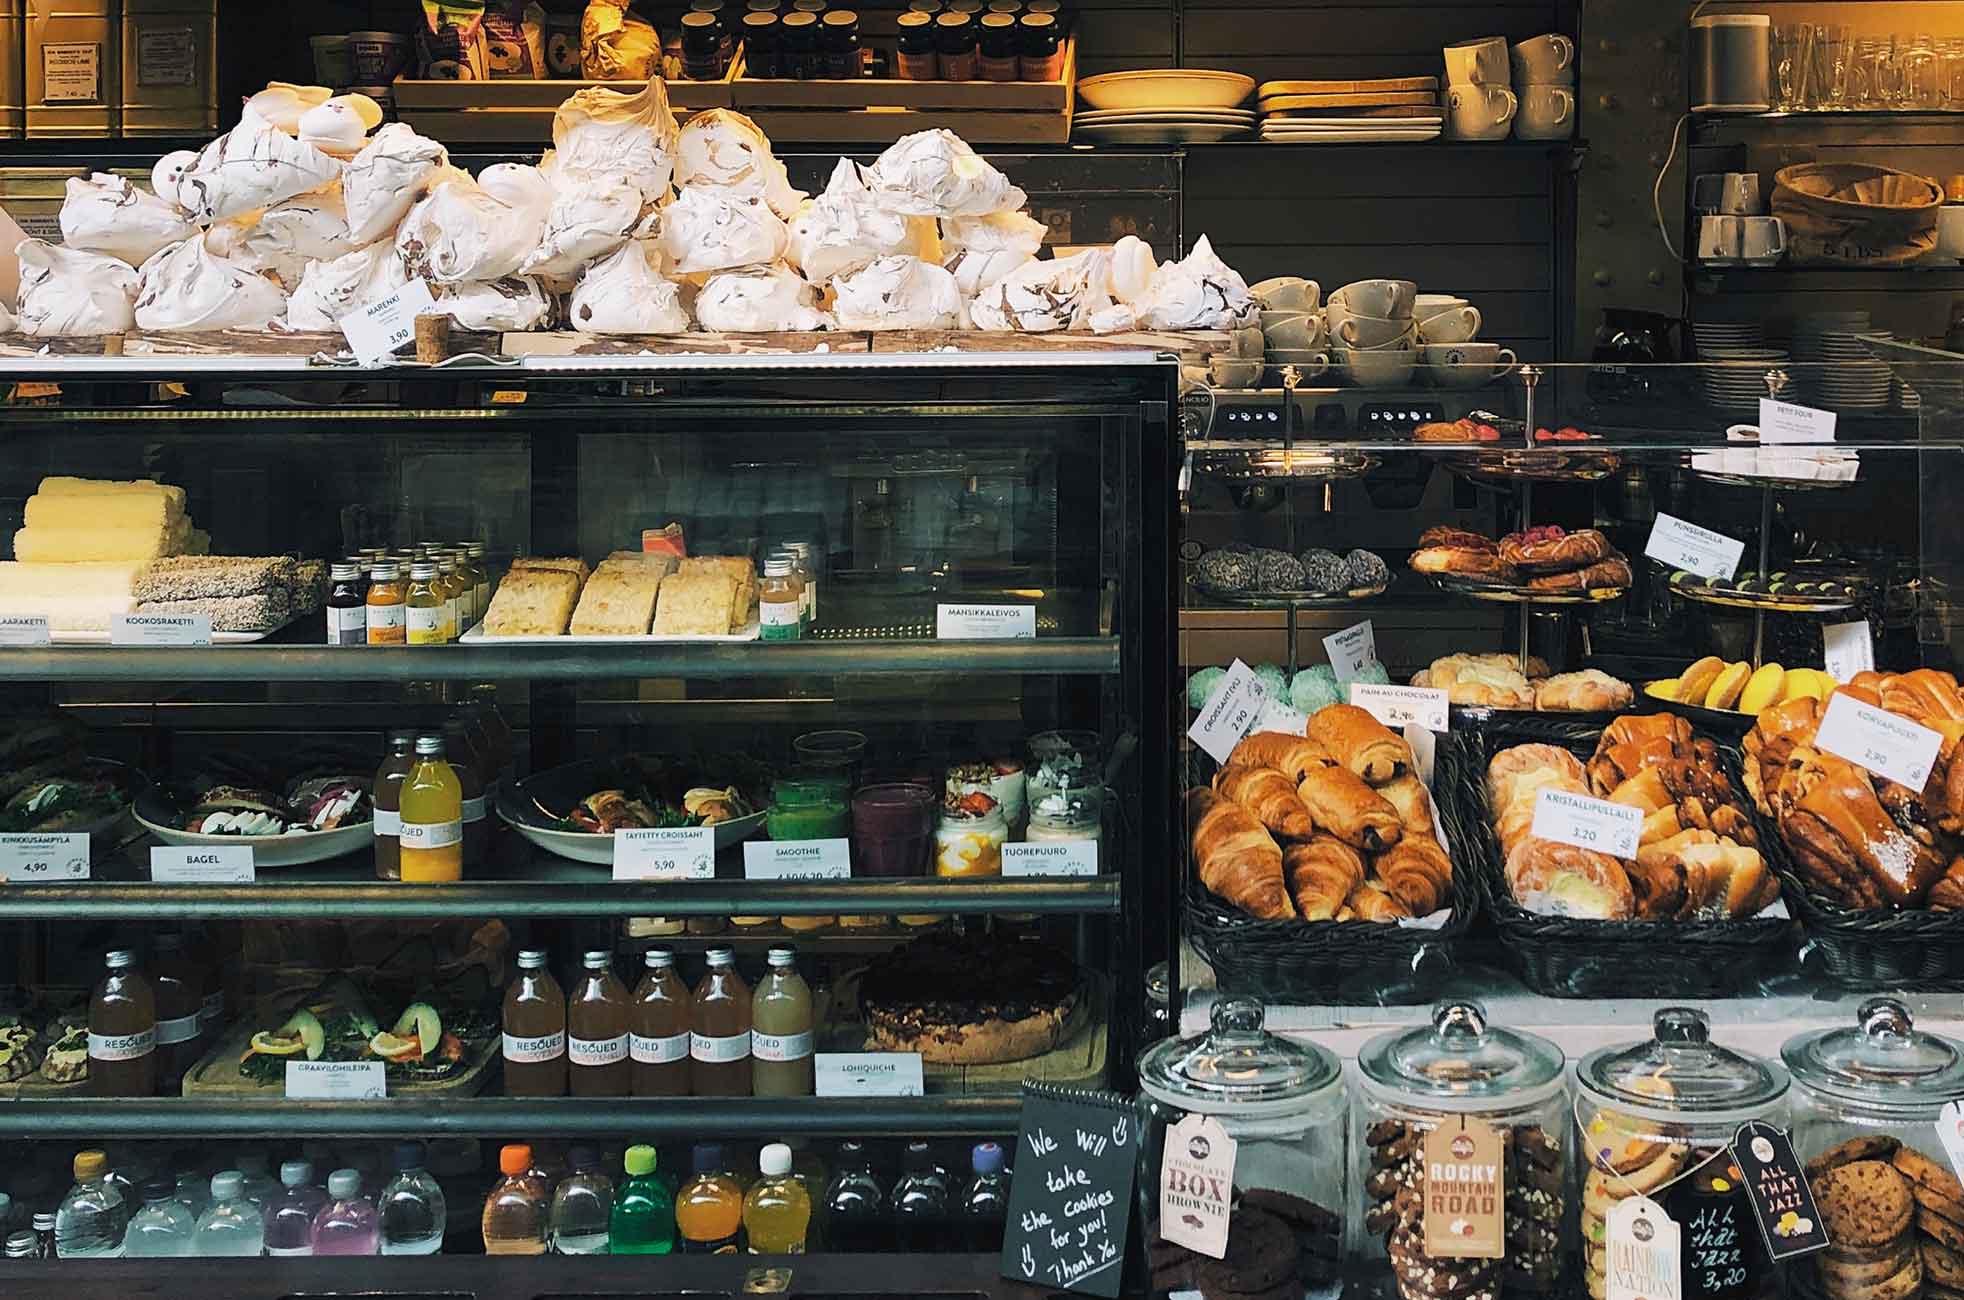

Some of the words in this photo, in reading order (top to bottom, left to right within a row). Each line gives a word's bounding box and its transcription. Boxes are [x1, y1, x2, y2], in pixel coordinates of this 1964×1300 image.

[367, 294, 400, 314] MARENKI
[389, 329, 409, 344] 3,90
[126, 617, 194, 626] KOOKOSRAKETTI
[948, 608, 1021, 616] MANSIKKALEIVOS
[1394, 690, 1440, 699] CHOCOLAT
[1203, 691, 1233, 732] CROISSANT
[660, 831, 703, 840] CROISSANT
[187, 856, 220, 864] BAGEL
[776, 848, 821, 856] SMOOTHIE
[1005, 847, 1067, 857] TUOREPUURO
[24, 863, 47, 872] 4,90
[654, 861, 675, 871] 5,90
[517, 1036, 562, 1051] RESCUED
[572, 1042, 617, 1053] RESCUED
[842, 1064, 896, 1073] LOHIQUICHE
[1027, 1127, 1059, 1158] We
[1076, 1128, 1108, 1157] Will
[1046, 1164, 1091, 1192] take
[1431, 1163, 1496, 1183] ROCKY
[1760, 1165, 1787, 1181] ALL
[1168, 1167, 1226, 1203] BOX
[1431, 1181, 1496, 1196] MOUNTAIN
[1757, 1176, 1797, 1198] THAT
[1021, 1210, 1053, 1232] the
[1063, 1190, 1114, 1217] cookies
[1167, 1193, 1225, 1216] BROWNIE
[1432, 1196, 1494, 1216] ROAD
[1769, 1193, 1803, 1213] JAZZ
[1050, 1227, 1070, 1250] for
[1078, 1208, 1107, 1248] you!
[1046, 1249, 1095, 1283] Thank
[1612, 1240, 1673, 1282] RAINBOW
[1614, 1270, 1673, 1299] NATION
[1702, 1267, 1746, 1292] 3,20
